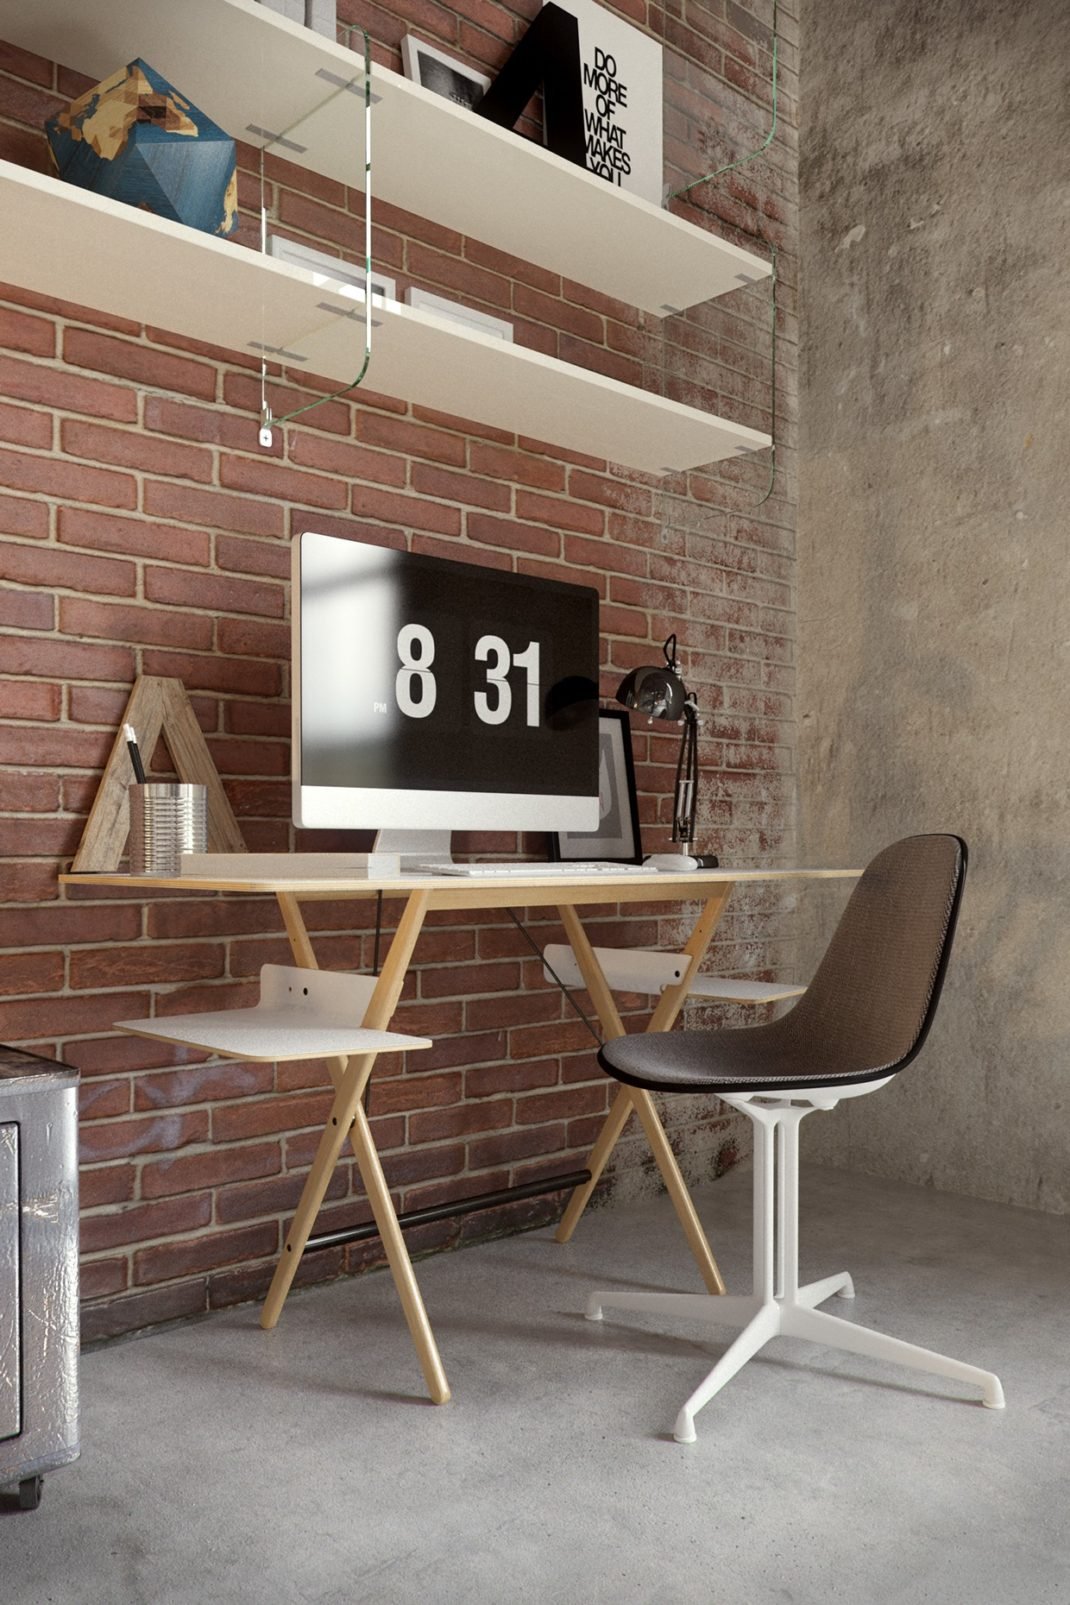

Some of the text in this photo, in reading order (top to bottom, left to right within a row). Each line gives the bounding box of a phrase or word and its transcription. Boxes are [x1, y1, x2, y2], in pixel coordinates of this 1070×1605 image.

[594, 46, 617, 78] DO
[583, 62, 628, 108] MORE
[595, 94, 616, 121] OF
[584, 108, 627, 150] WHAT
[395, 623, 540, 727] 8 31
[373, 702, 387, 713] PM
